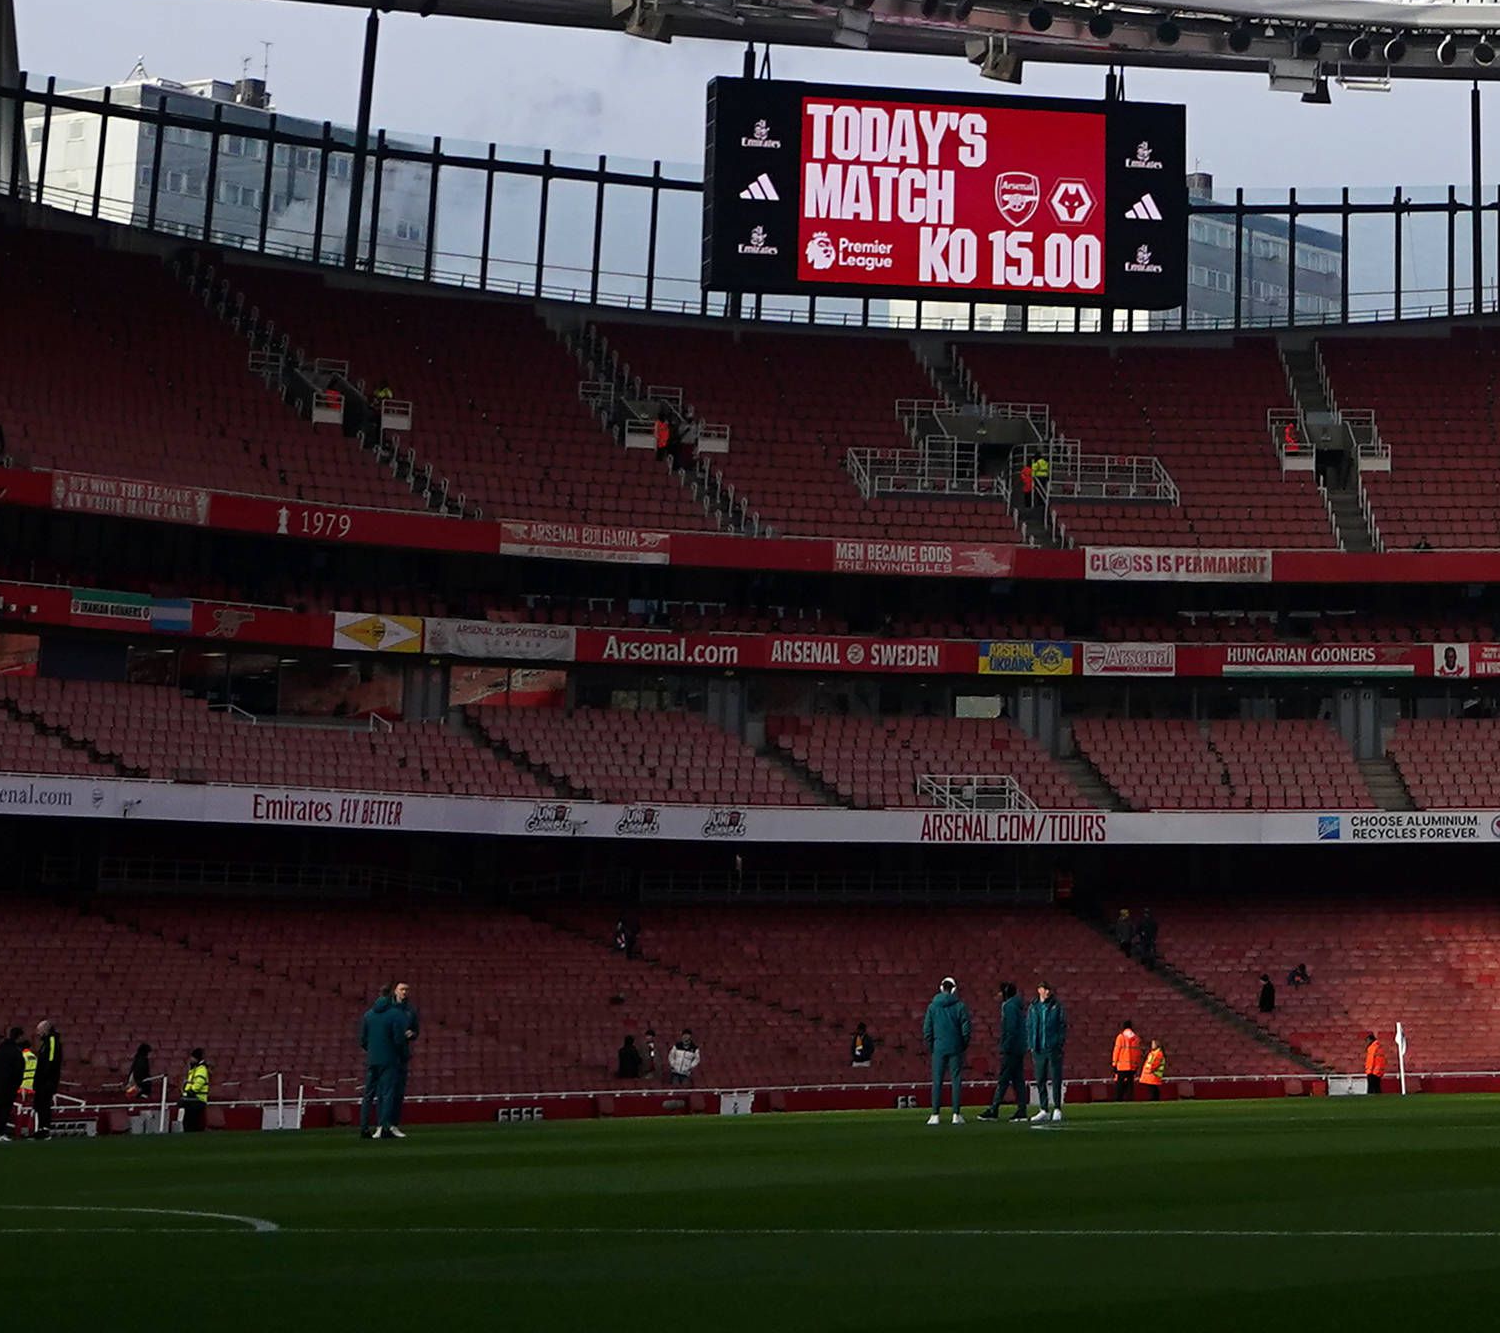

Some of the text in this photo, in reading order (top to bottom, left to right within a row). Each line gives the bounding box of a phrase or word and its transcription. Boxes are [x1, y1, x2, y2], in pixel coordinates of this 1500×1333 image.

[741, 136, 781, 149] Emirates
[806, 104, 988, 169] TODAY'S
[1125, 157, 1163, 170] Emirates
[805, 162, 955, 225] MATCH
[1001, 180, 1034, 191] Arsenal
[738, 243, 778, 256] Emirates
[839, 236, 893, 255] Premier
[838, 254, 893, 271] League
[918, 226, 1102, 291] KO 15.00
[1125, 261, 1163, 274] Emirates
[66, 491, 85, 507] AT
[69, 476, 191, 503] WE WON THE LEAGUE
[301, 510, 352, 538] 1979
[531, 524, 579, 543] ARSENAL
[836, 542, 953, 563] MEN BECAME GODS
[836, 561, 953, 573] THE INVINCIBLES
[1091, 554, 1267, 574] CLSS IS PERMANENT
[603, 635, 738, 664] Arsenal.com
[771, 640, 938, 667] ARSENAL SWEDEN
[990, 642, 1034, 657] ARSENAL
[1106, 645, 1173, 665] Arsenal
[1227, 647, 1376, 663] HUNGARIAN GOONERS
[253, 794, 403, 826] Emirates FLY BETTER
[921, 813, 1106, 841] ARSENAL.COM/TOURS
[1351, 815, 1480, 827] CHOOSE ALUMINIUM.
[1352, 827, 1479, 840] RECYCLES FOREVER.
